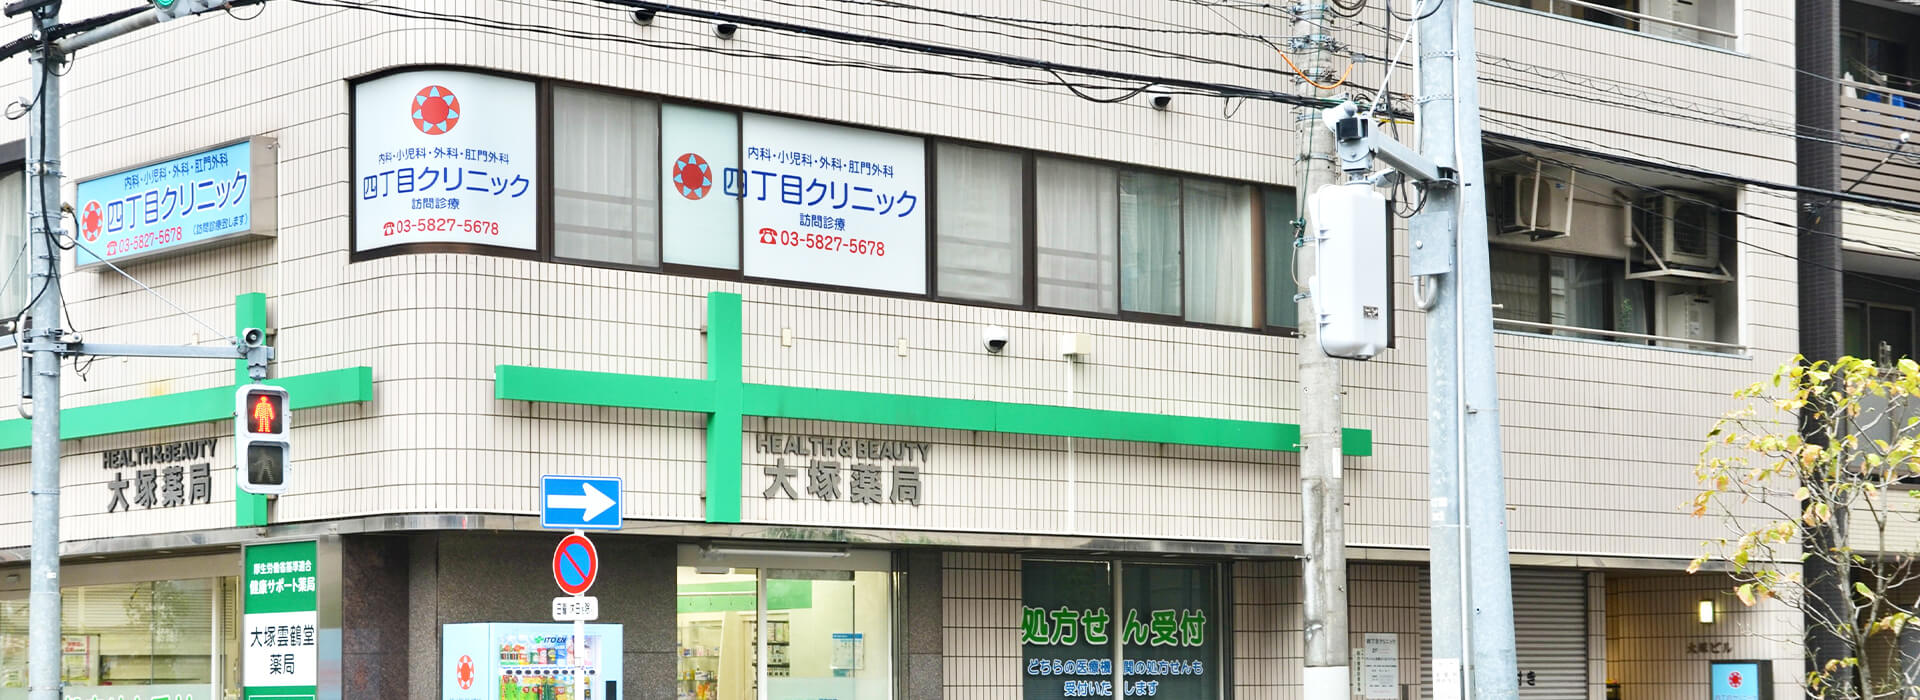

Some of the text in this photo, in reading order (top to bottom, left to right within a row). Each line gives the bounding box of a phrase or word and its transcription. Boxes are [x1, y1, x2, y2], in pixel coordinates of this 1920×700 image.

[363, 166, 530, 200] 四丁目クリニック
[723, 167, 917, 217] 四丁目クリニック
[107, 170, 248, 233] 四丁目クリニック
[411, 197, 460, 210] 訪問診療
[396, 218, 499, 236] 03-5827-5678
[799, 213, 846, 231] 訪問診療
[118, 226, 183, 254] 03-5827-5678
[780, 230, 885, 257] 03-5827-5678
[107, 462, 212, 513] 大塚薬局
[763, 458, 923, 507] 大塚薬局
[249, 576, 316, 595] 健康サポート薬局
[250, 624, 315, 648] 大塚雲鶴堂
[1021, 606, 1206, 646] 処方せん受付
[269, 653, 295, 675] 薬局
[1063, 680, 1159, 697] 受付いたします
